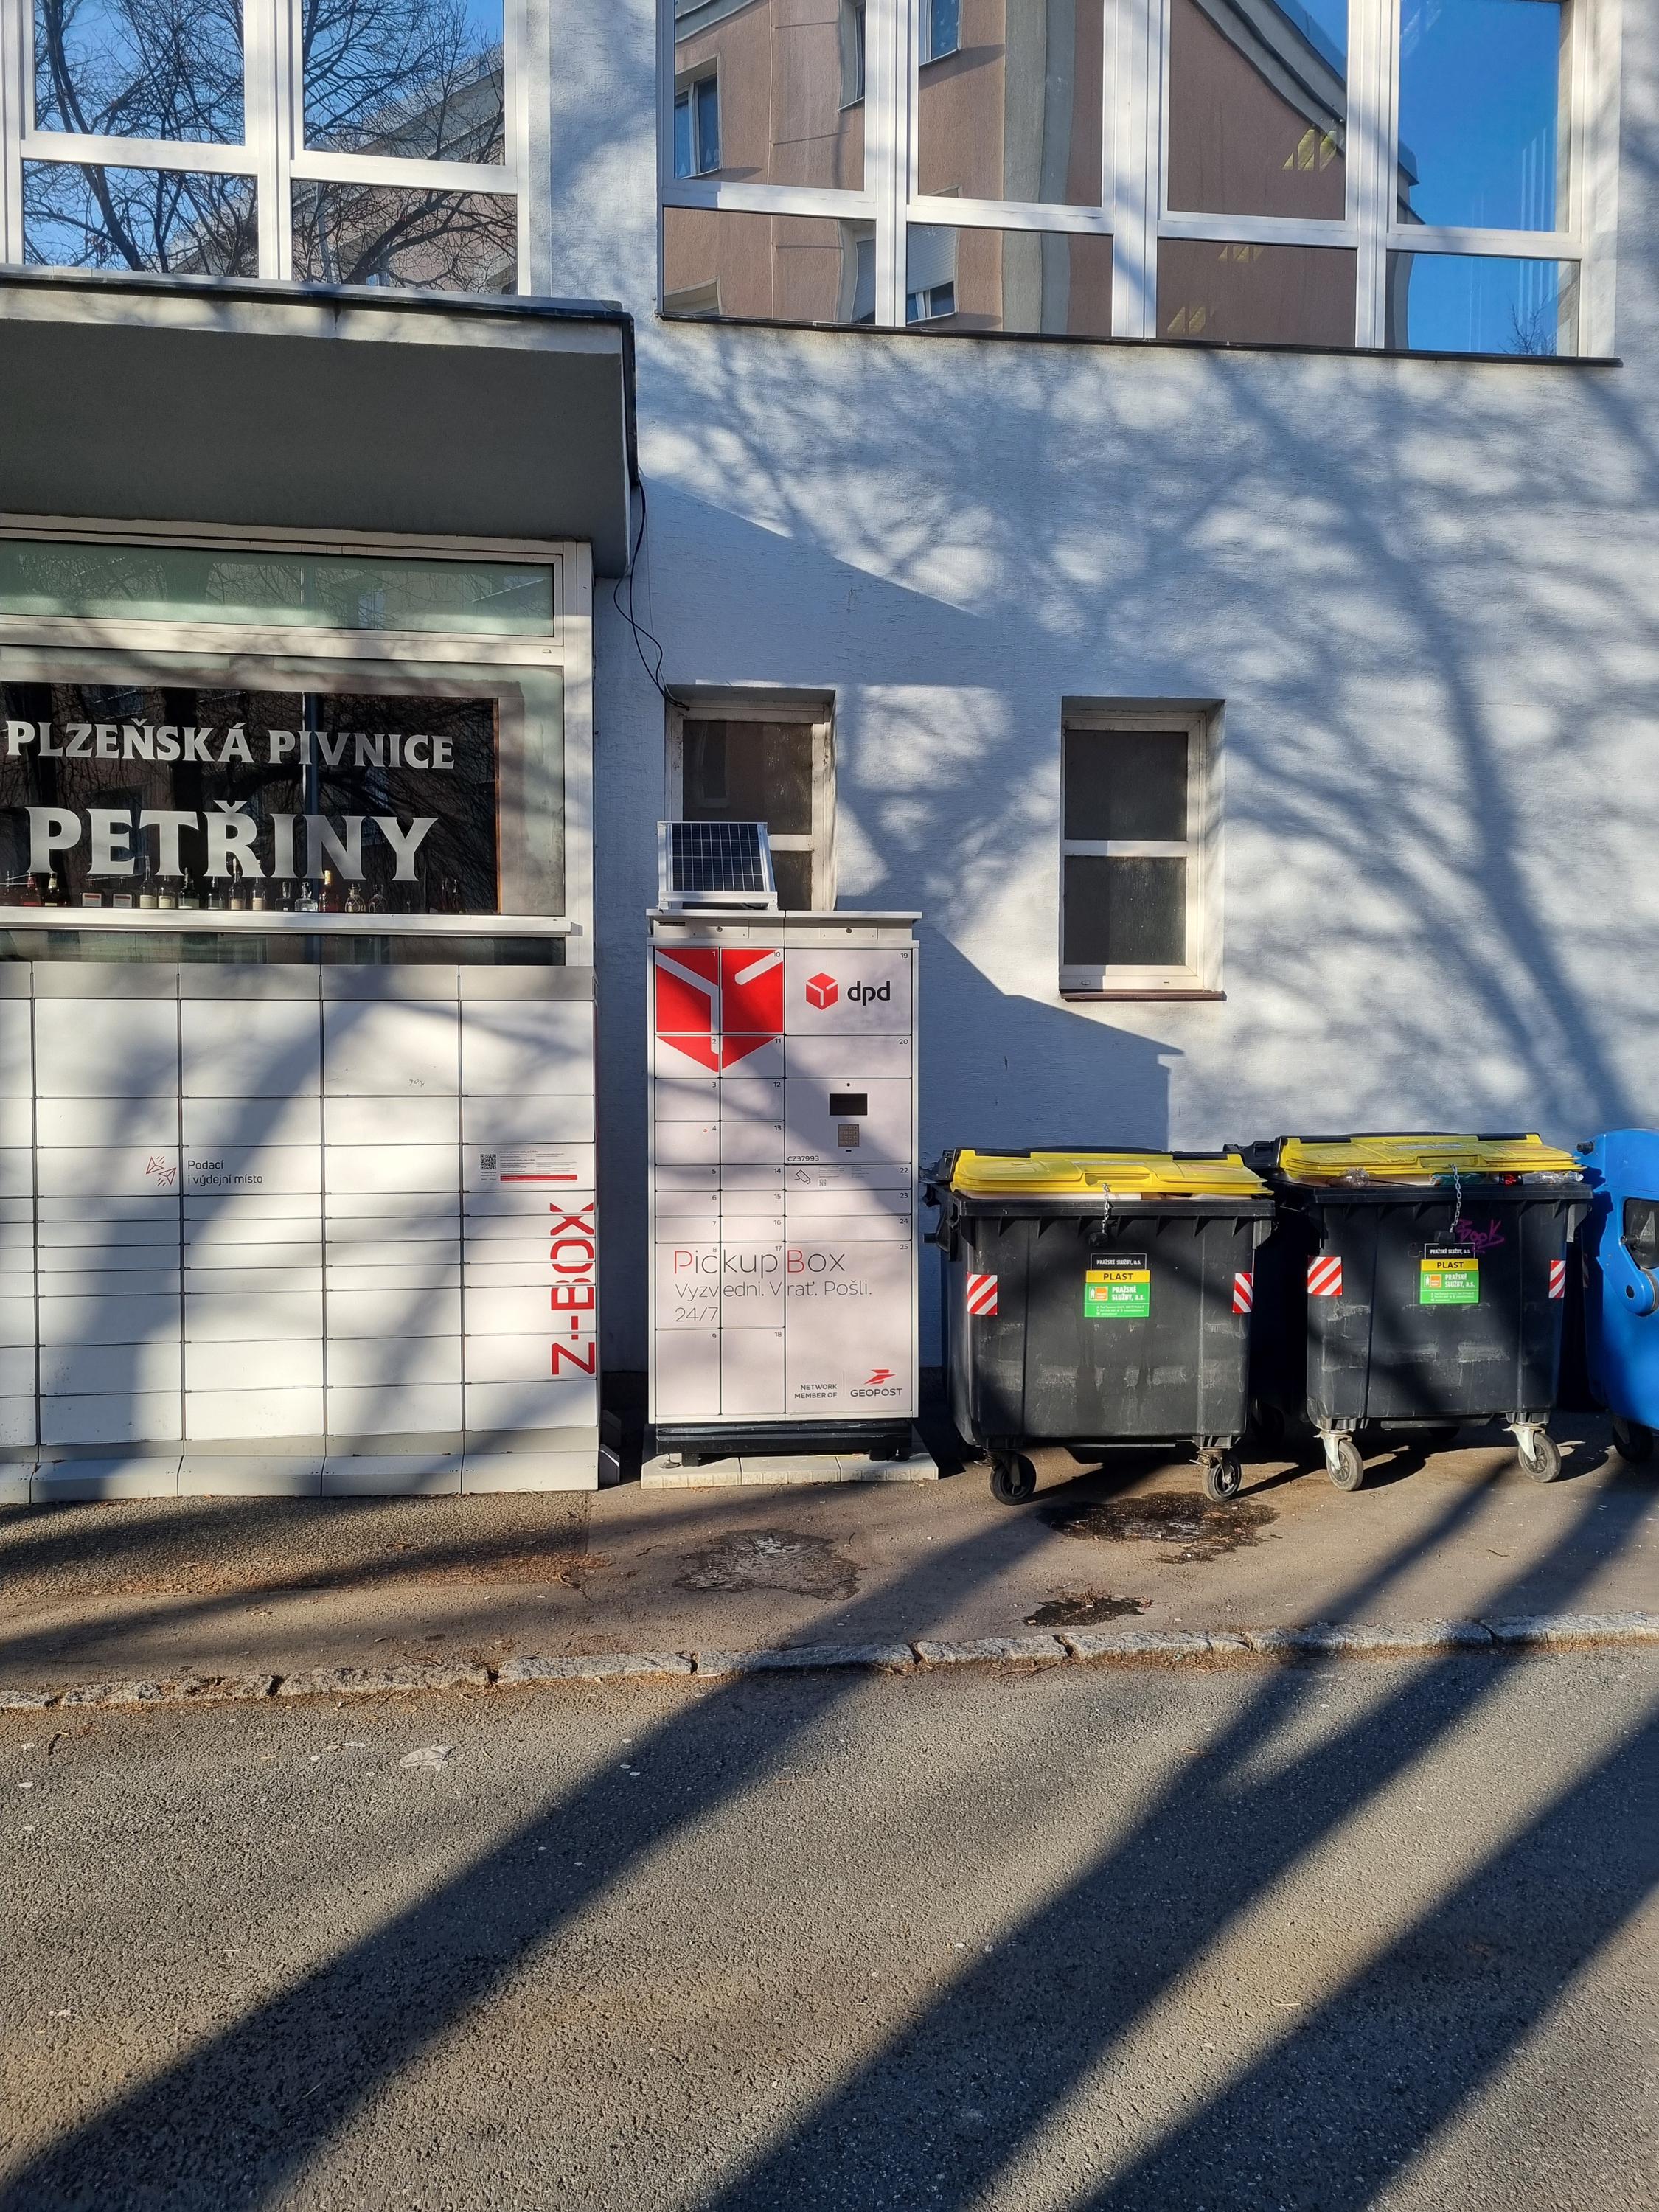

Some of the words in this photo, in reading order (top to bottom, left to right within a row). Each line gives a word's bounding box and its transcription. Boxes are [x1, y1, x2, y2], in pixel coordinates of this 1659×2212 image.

[6, 718, 254, 763] PLZEŇSKÁ
[268, 728, 454, 769] PIVNICE
[24, 800, 438, 881] PETŘINY
[847, 981, 891, 1006] dpd
[188, 1159, 224, 1170] Podací
[192, 1174, 232, 1187] výdejní
[234, 1173, 262, 1184] místo
[1103, 1273, 1133, 1281] PLAST
[549, 1203, 596, 1375] Z-BOX
[675, 1282, 765, 1301] Vyzvedni.
[769, 1281, 818, 1297] Vrať.
[824, 1280, 872, 1296] Pošli.
[1111, 1285, 1137, 1293] PRAŽSKÉ
[675, 1307, 719, 1322] 24/7
[850, 1388, 903, 1397] GEOPOST
